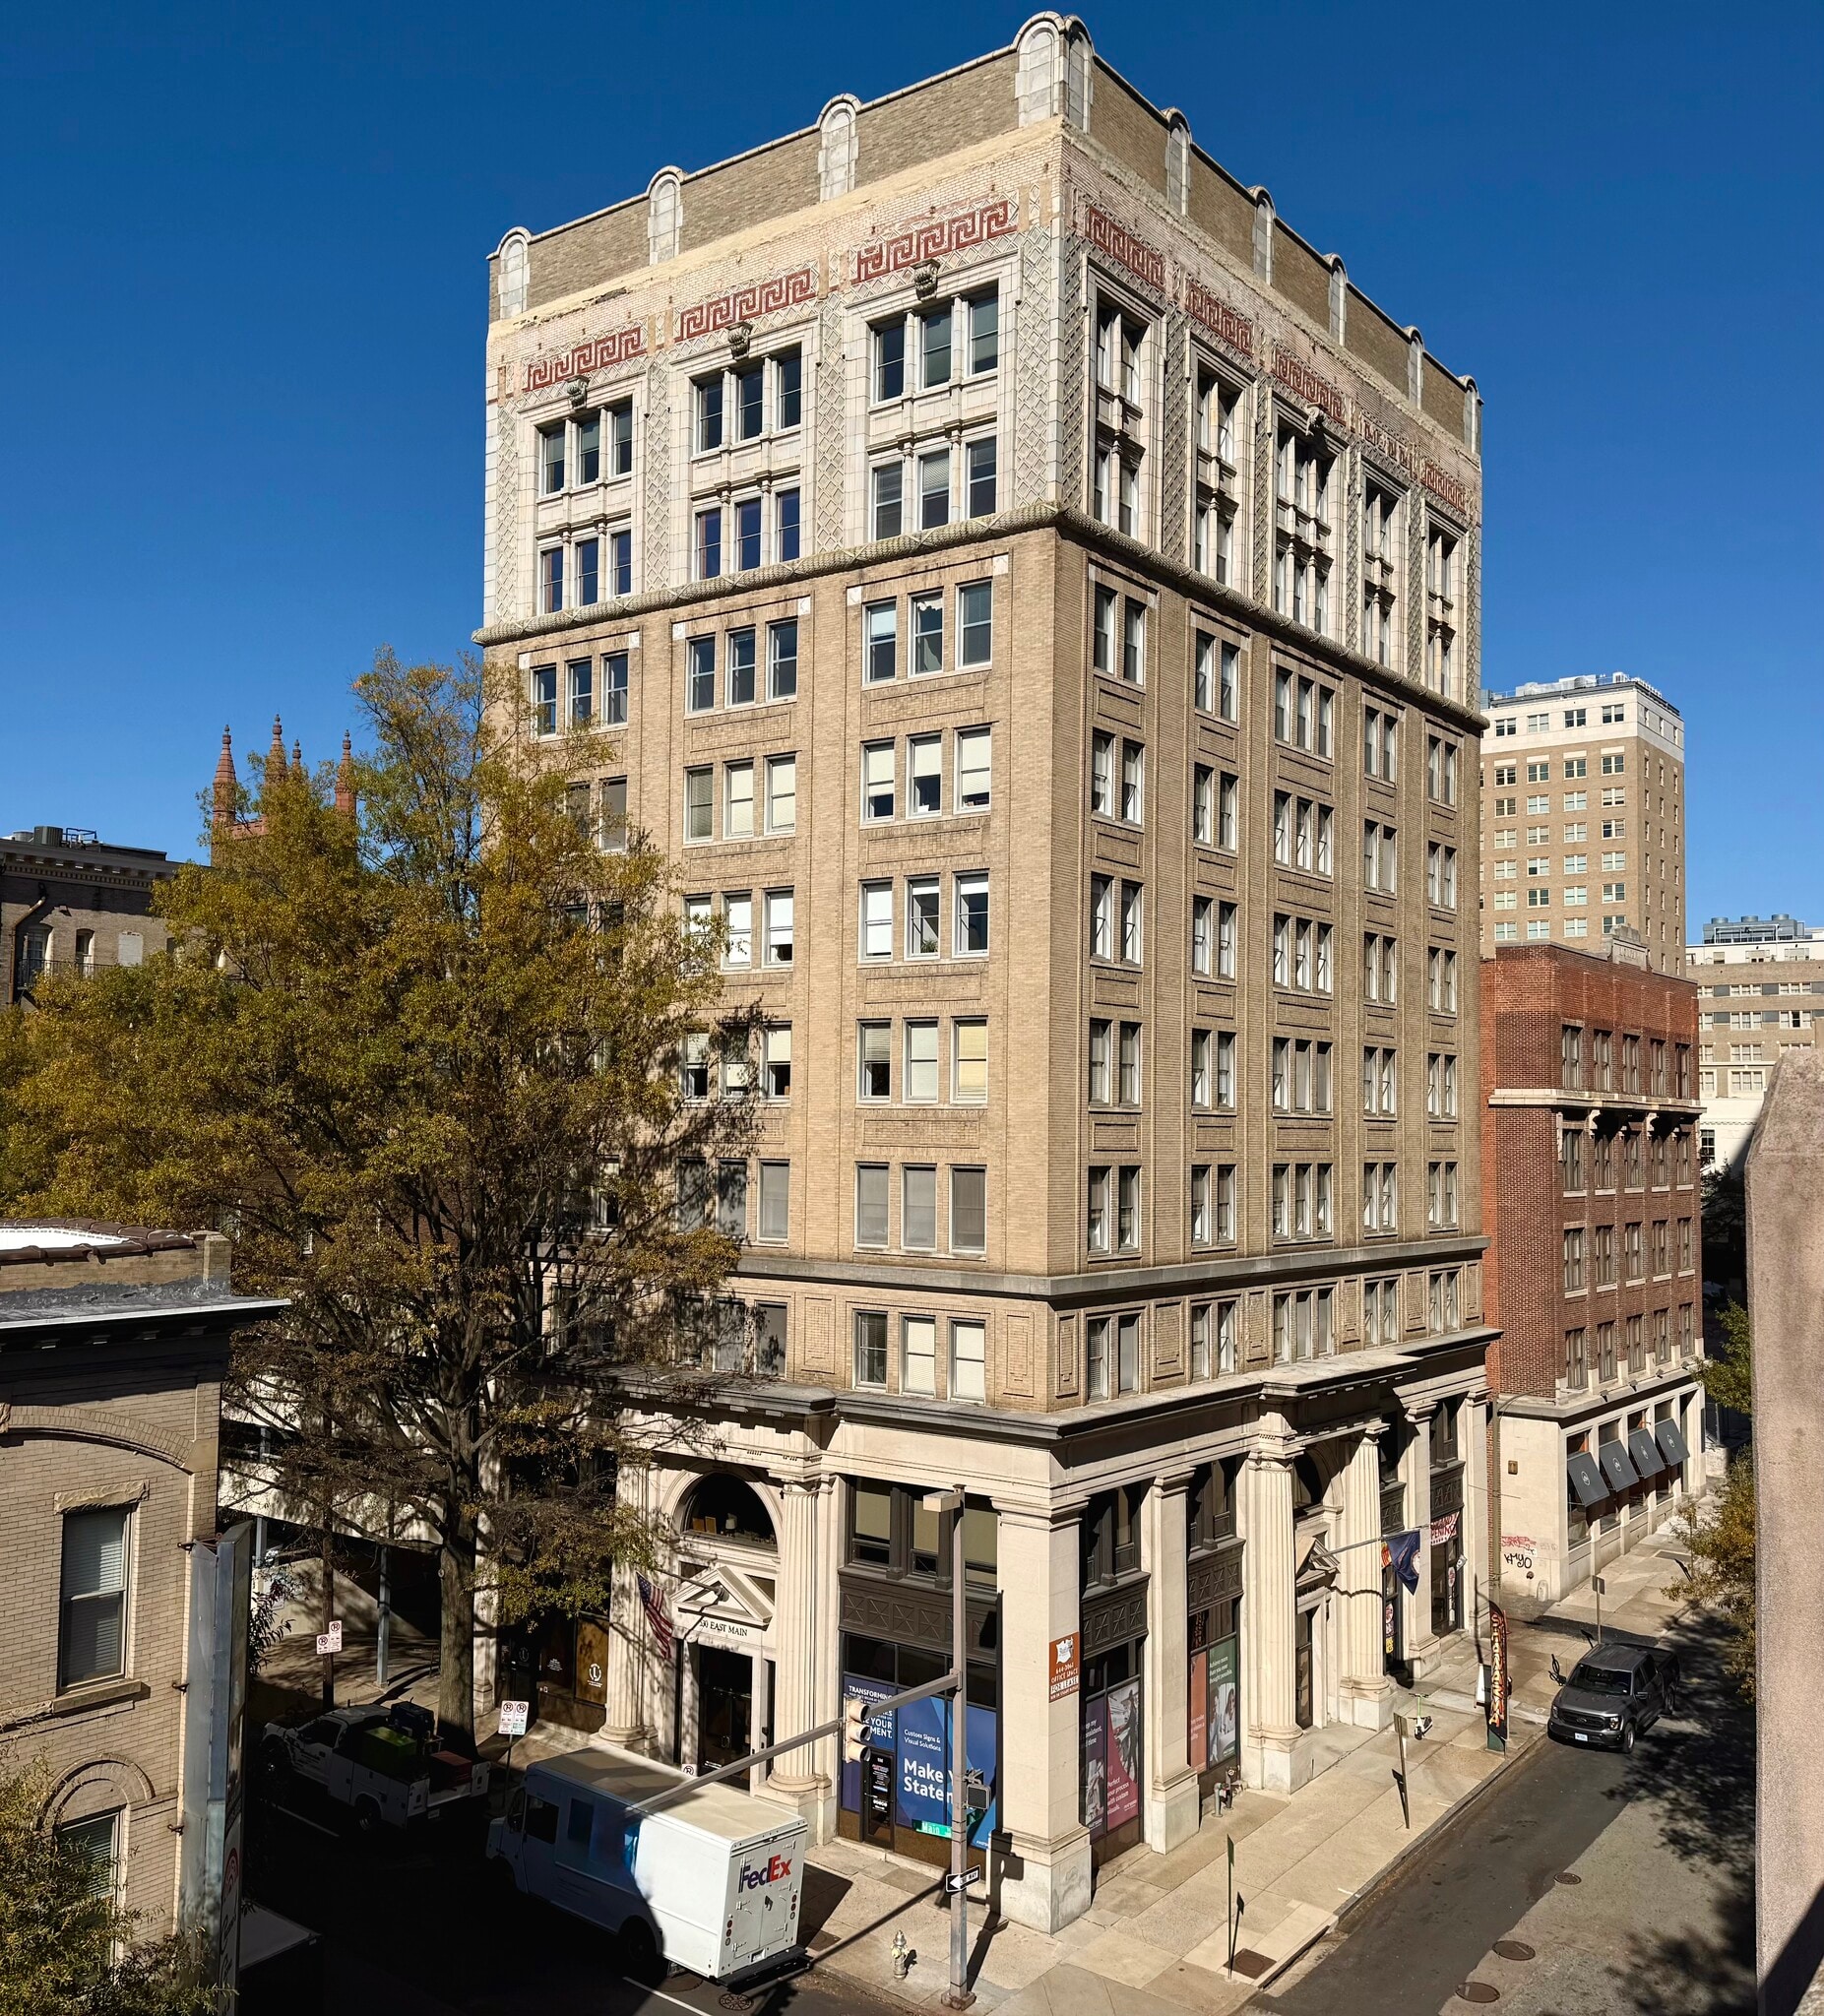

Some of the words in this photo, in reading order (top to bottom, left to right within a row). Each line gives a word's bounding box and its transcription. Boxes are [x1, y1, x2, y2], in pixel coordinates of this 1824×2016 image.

[710, 1621, 726, 1633] EAST
[728, 1625, 748, 1636] MAIN
[1050, 1672, 1066, 1684] OFFICE
[1051, 1683, 1062, 1693] FOR
[1062, 1676, 1078, 1688] LEASE
[870, 1717, 893, 1731] YOUR
[904, 1729, 923, 1739] Custom
[923, 1733, 936, 1742] Signs
[904, 1736, 919, 1746] Visual
[919, 1740, 942, 1752] Solutions
[904, 1757, 944, 1784] Make
[921, 1820, 940, 1835] Main
[738, 1854, 792, 1893] FedEx
